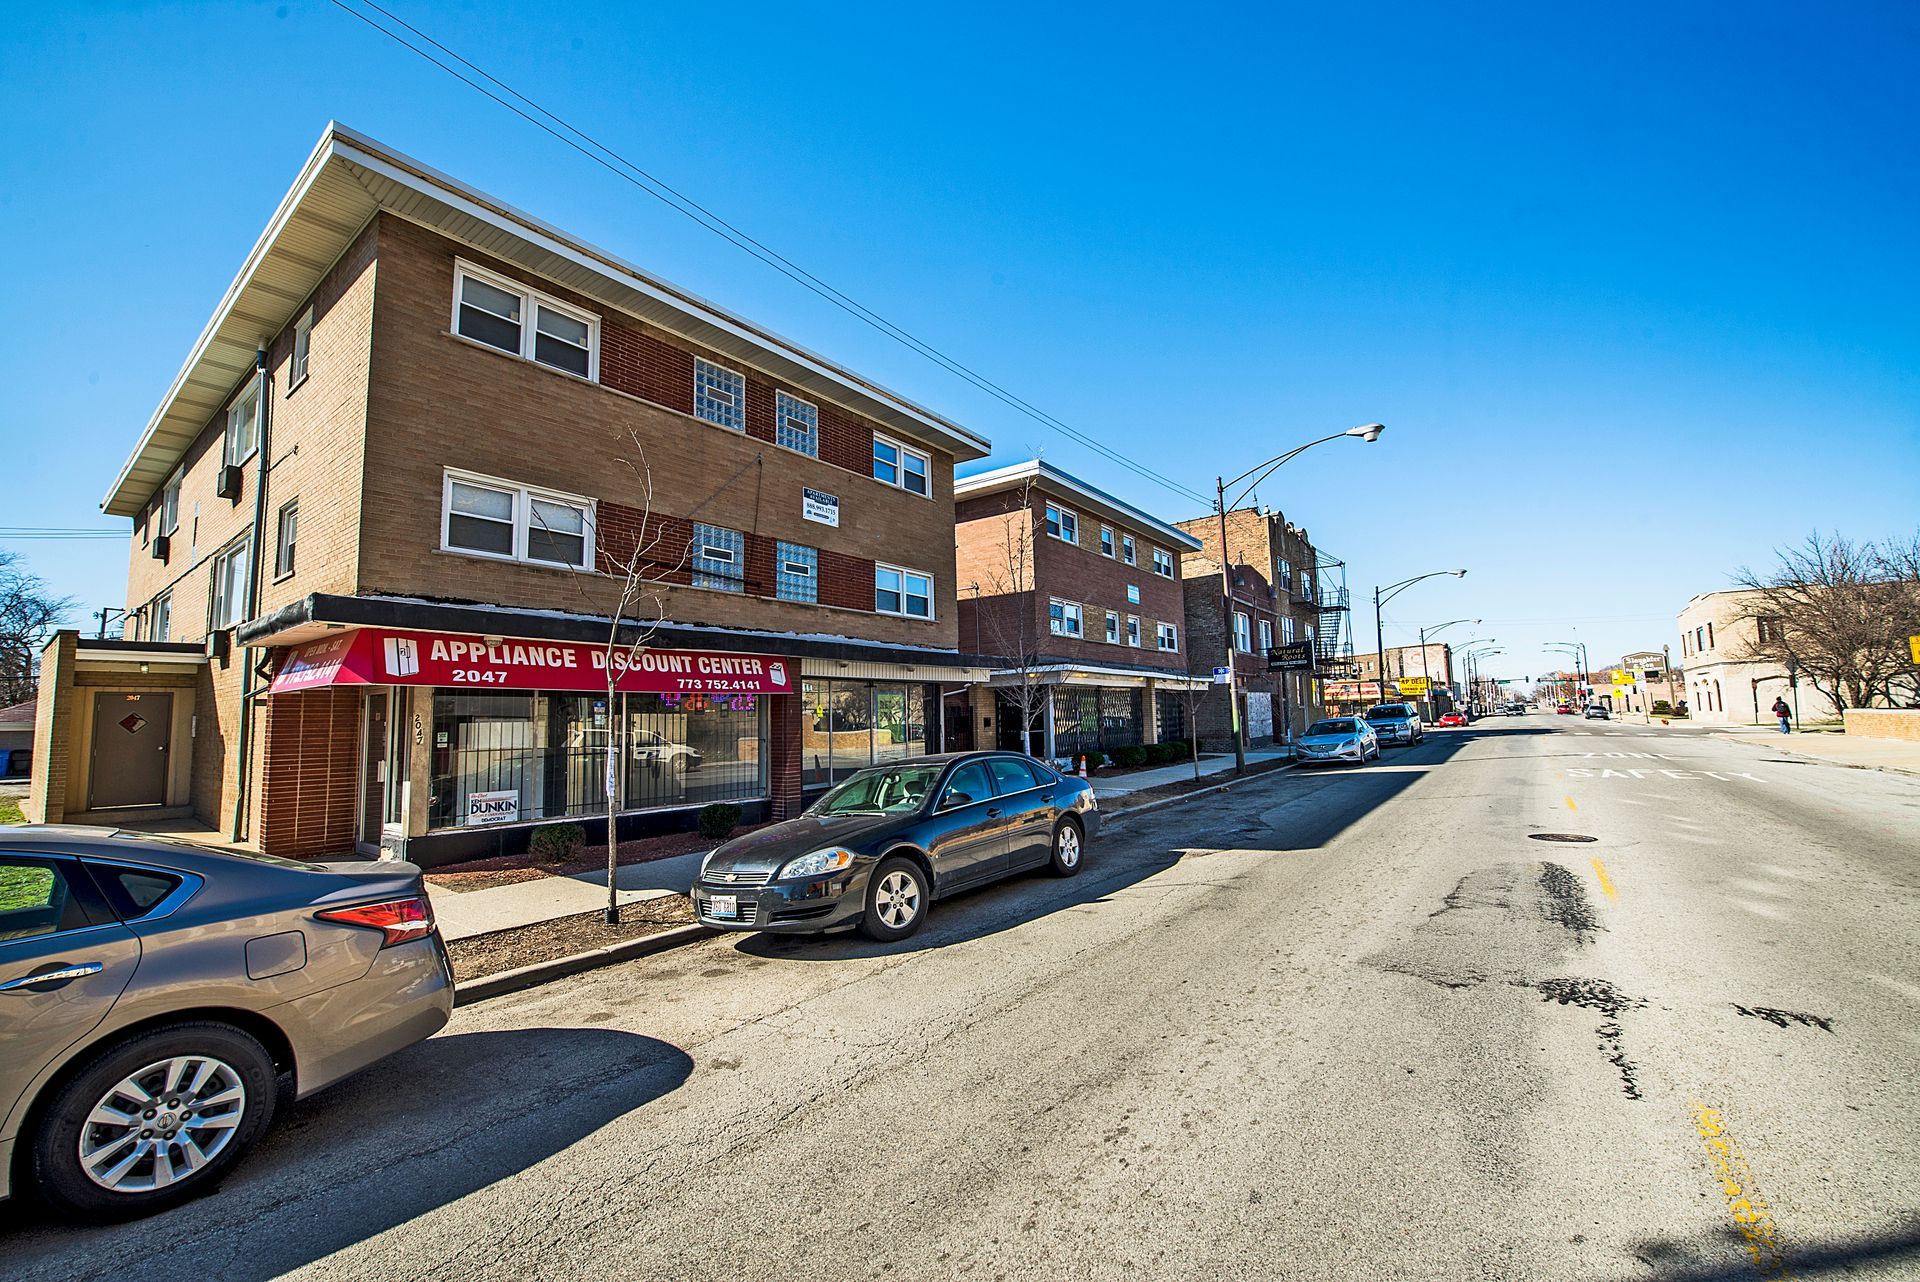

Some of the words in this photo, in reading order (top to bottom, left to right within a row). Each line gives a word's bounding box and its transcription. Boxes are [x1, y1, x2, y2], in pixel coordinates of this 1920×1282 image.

[806, 489, 836, 502] APARTMENTS
[431, 640, 577, 668] APPLIANCE
[697, 656, 763, 675] CENTER
[1271, 646, 1304, 656] Natural
[452, 669, 508, 683] 2047
[677, 679, 702, 689] 773
[705, 680, 760, 690] 752.4141
[415, 714, 423, 745] 2047
[1565, 768, 1768, 783] SAFETY
[471, 800, 517, 814] DUNKIN
